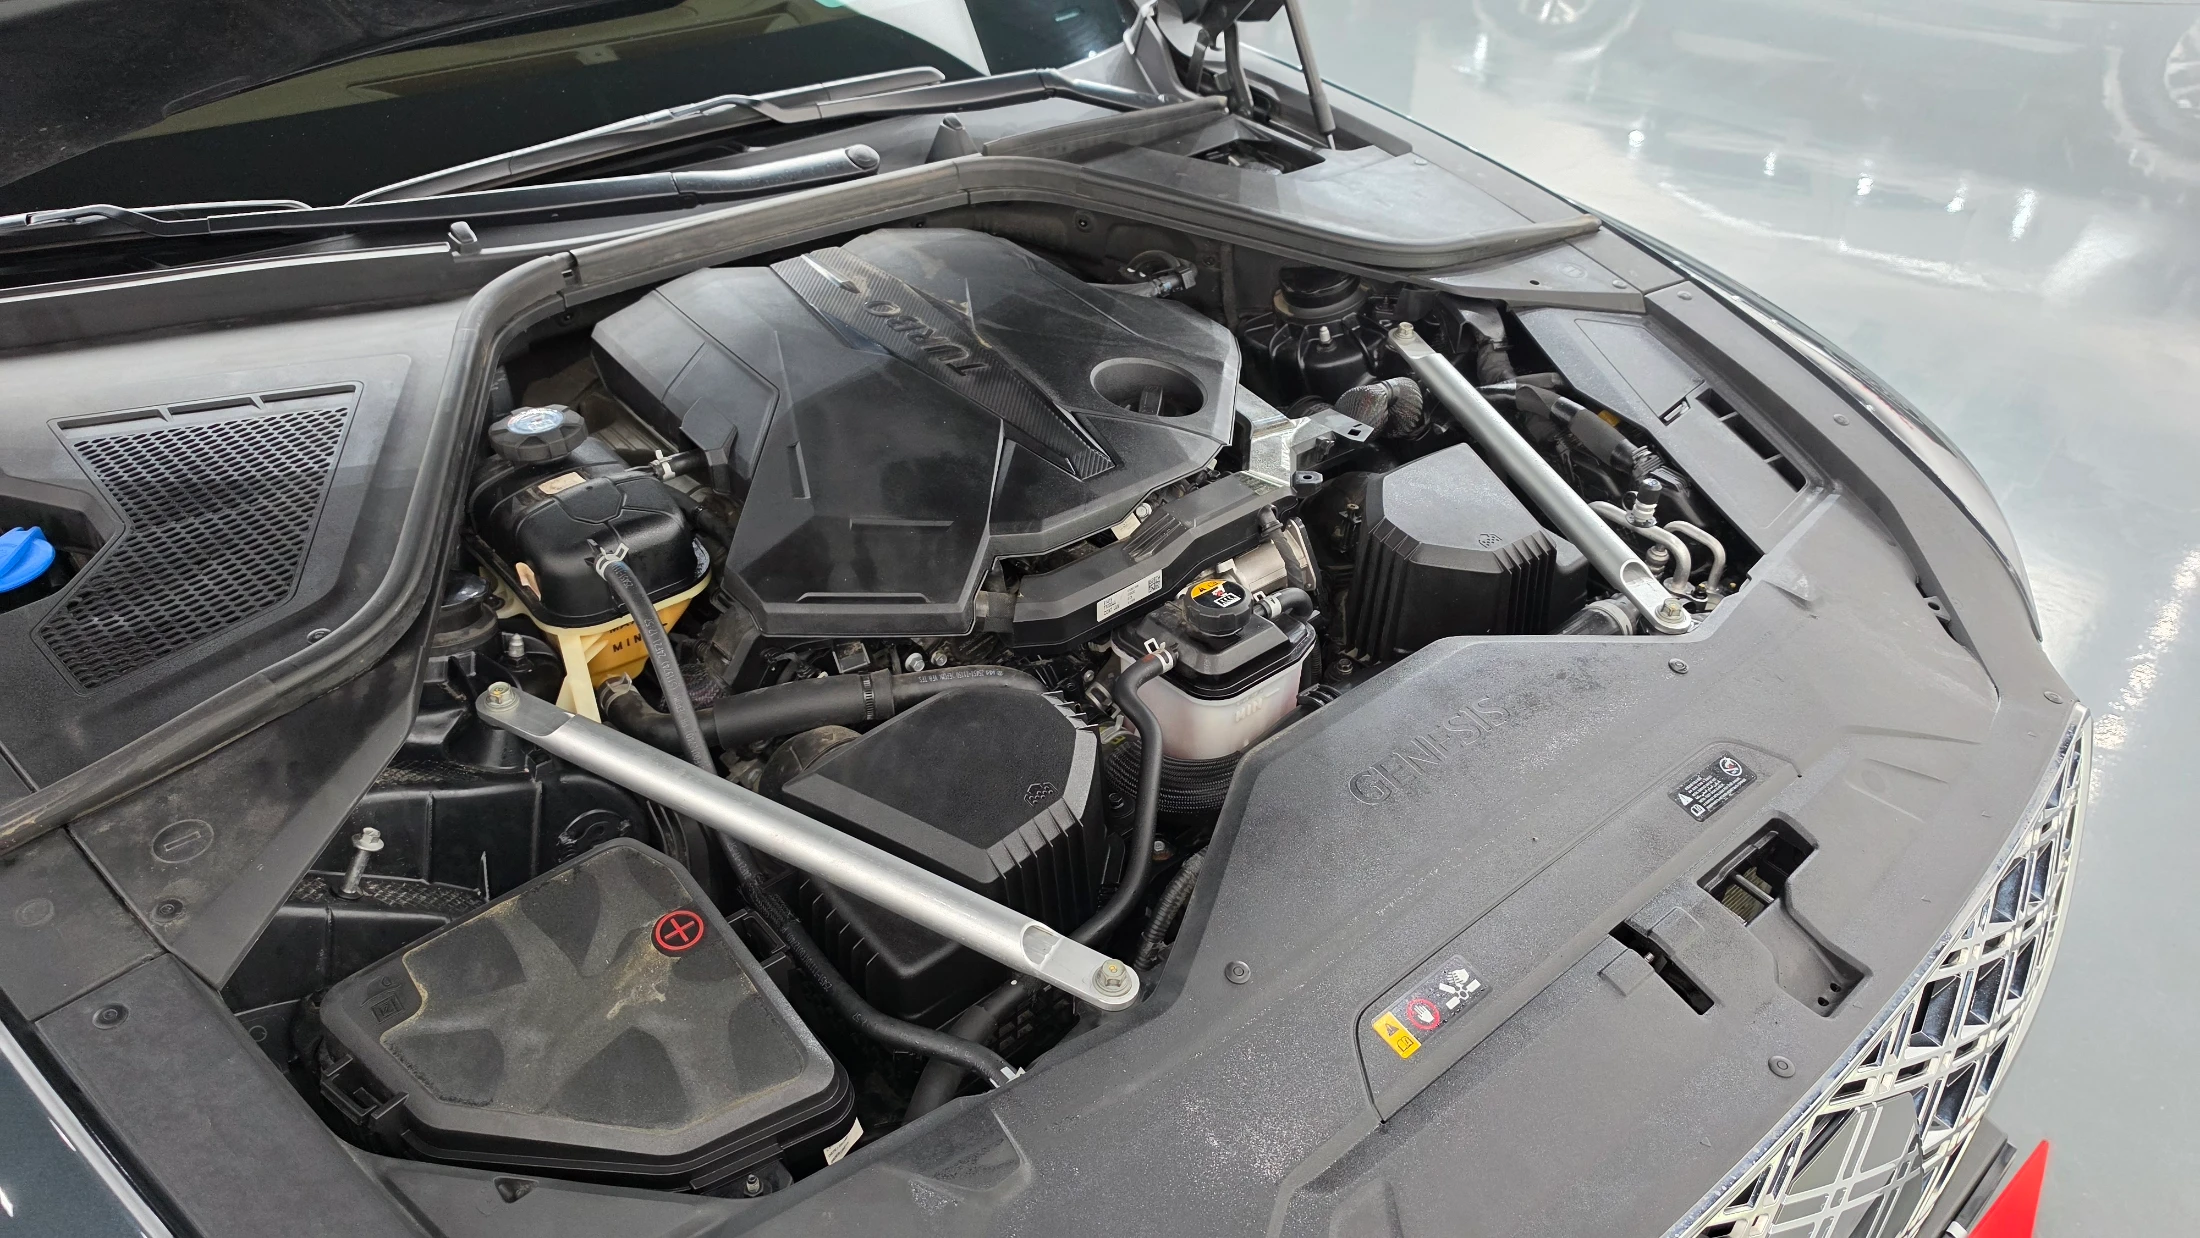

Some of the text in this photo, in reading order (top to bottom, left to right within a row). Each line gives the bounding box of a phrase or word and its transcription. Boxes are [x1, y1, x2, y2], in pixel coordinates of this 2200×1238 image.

[863, 300, 989, 377] TURBO
[613, 633, 642, 653] MIN
[1235, 696, 1263, 723] MIN
[1348, 697, 1511, 806] GENESIS
